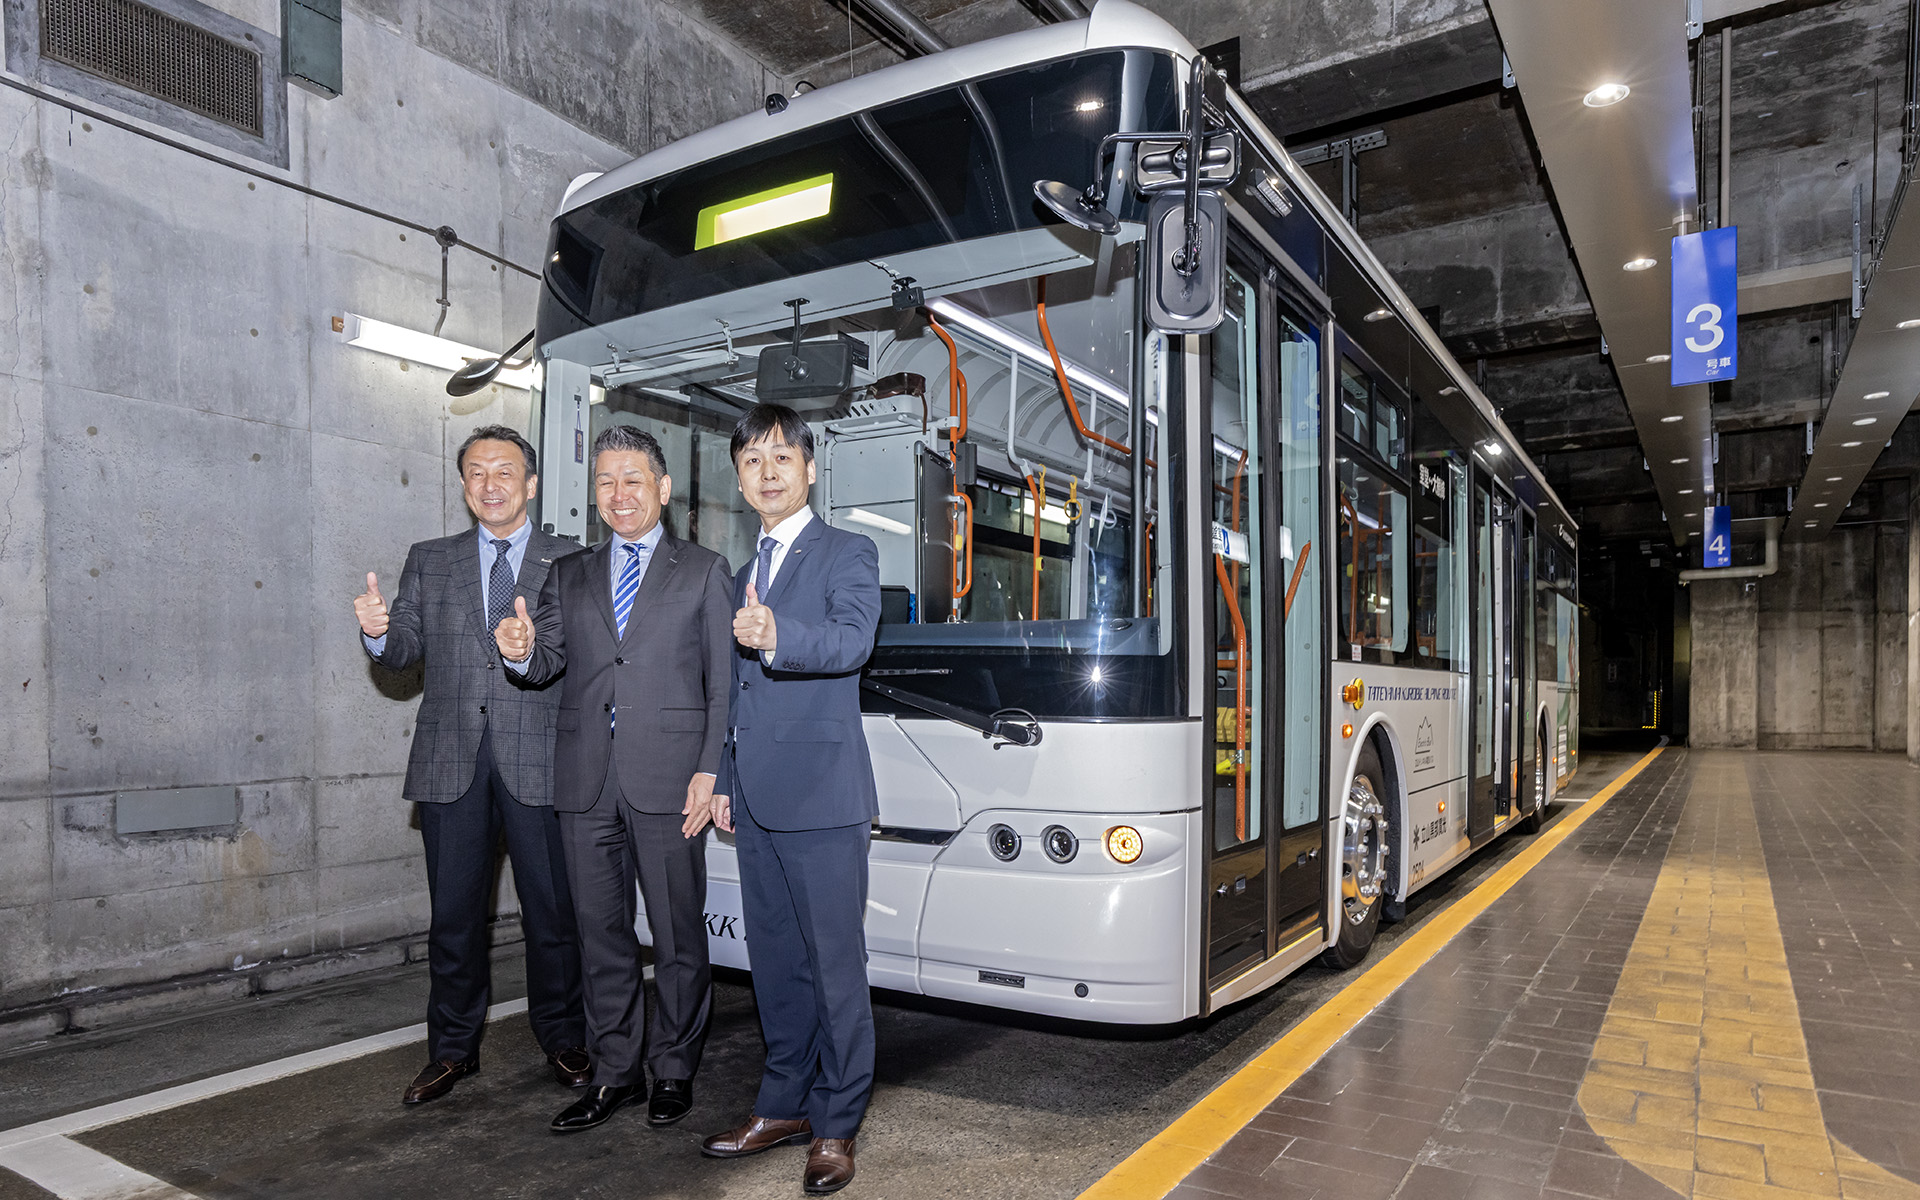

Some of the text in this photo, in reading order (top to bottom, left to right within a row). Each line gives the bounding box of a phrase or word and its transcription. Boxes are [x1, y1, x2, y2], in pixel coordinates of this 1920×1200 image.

[1684, 303, 1725, 354] 3
[1706, 356, 1731, 369] 号車
[1709, 534, 1726, 555] 4
[1367, 686, 1402, 701] TATEYAMA
[1402, 687, 1424, 701] KUROBE
